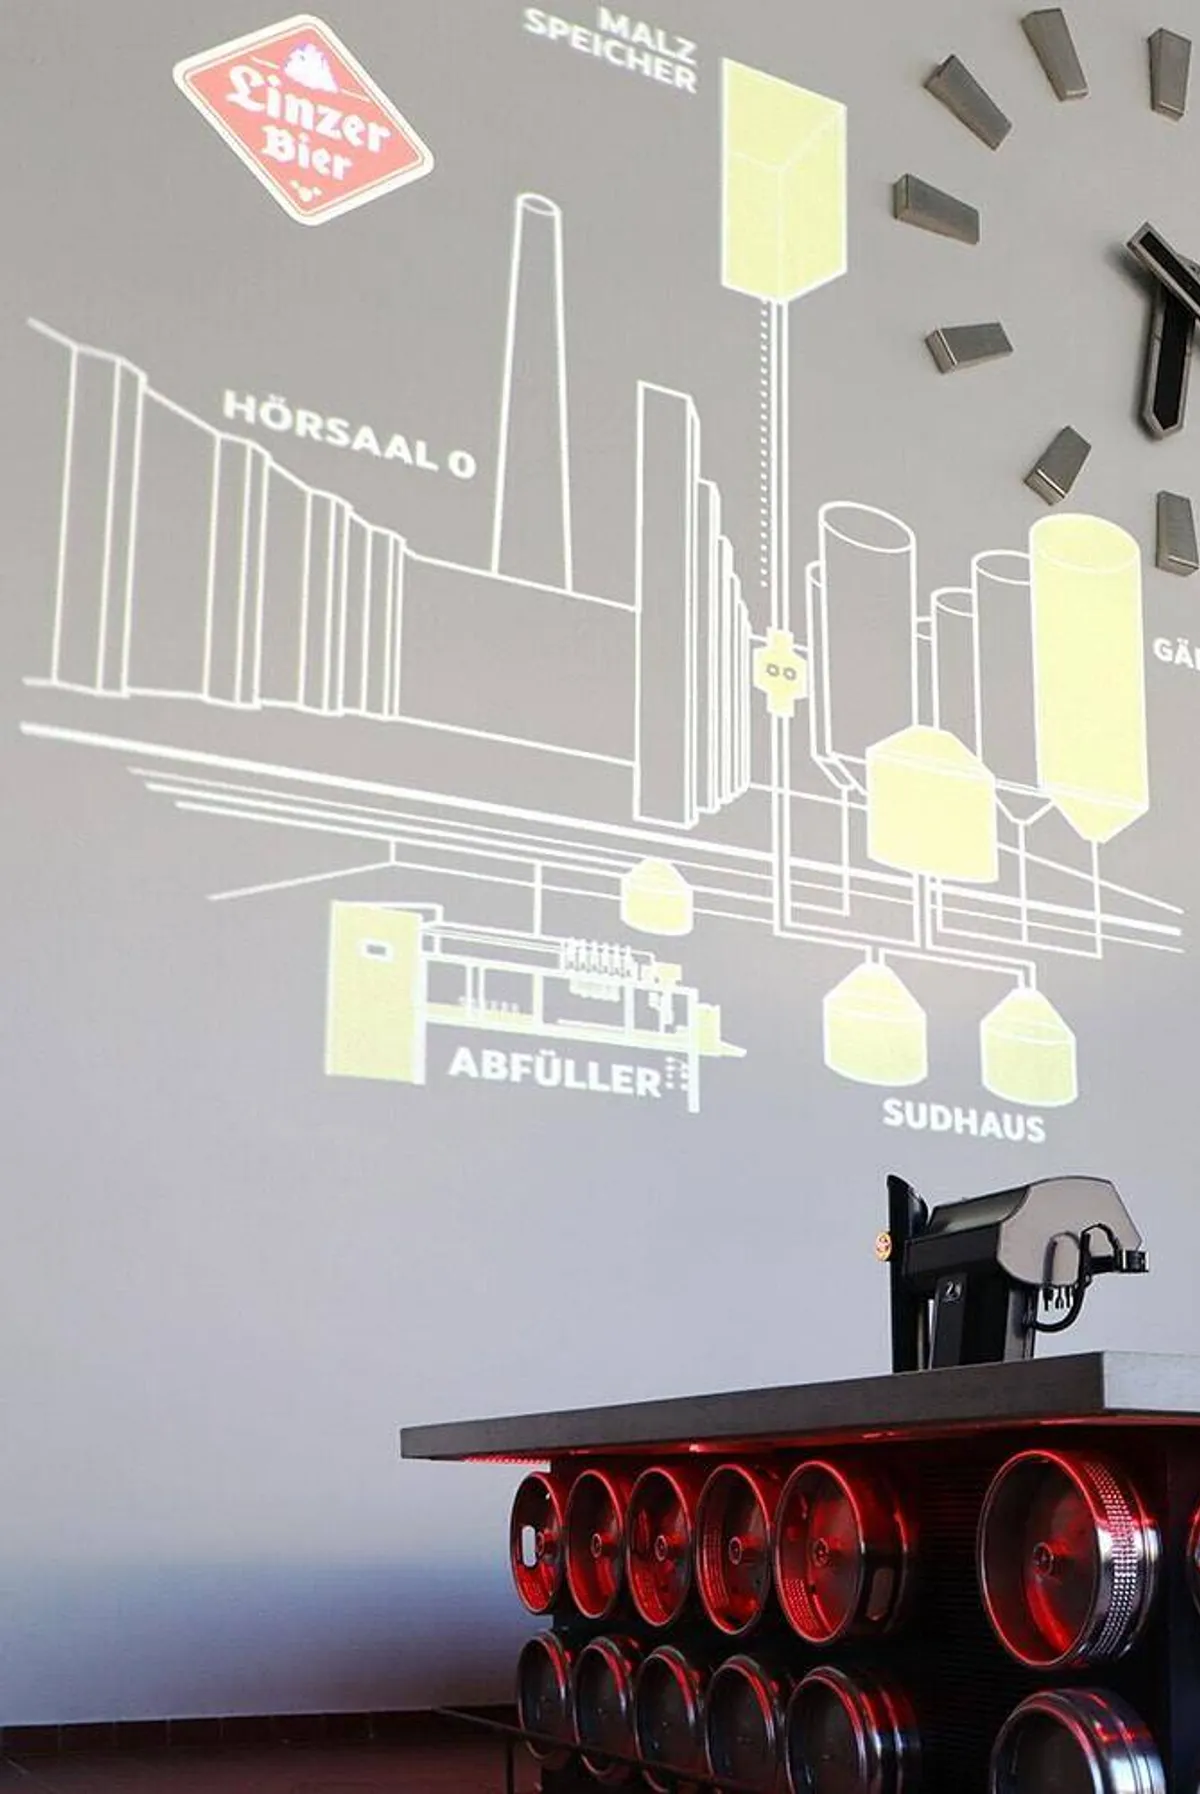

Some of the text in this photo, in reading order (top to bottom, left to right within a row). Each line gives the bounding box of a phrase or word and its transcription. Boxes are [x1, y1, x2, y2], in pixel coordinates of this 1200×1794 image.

[523, 7, 698, 94] SPEICHER
[598, 5, 698, 67] MALZ
[225, 64, 391, 153] Linzer
[260, 124, 352, 180] Bier
[223, 388, 439, 473] HÖRSAAL
[448, 1046, 662, 1099] ABFÜLLER
[882, 1097, 1046, 1143] SUDHAUS
